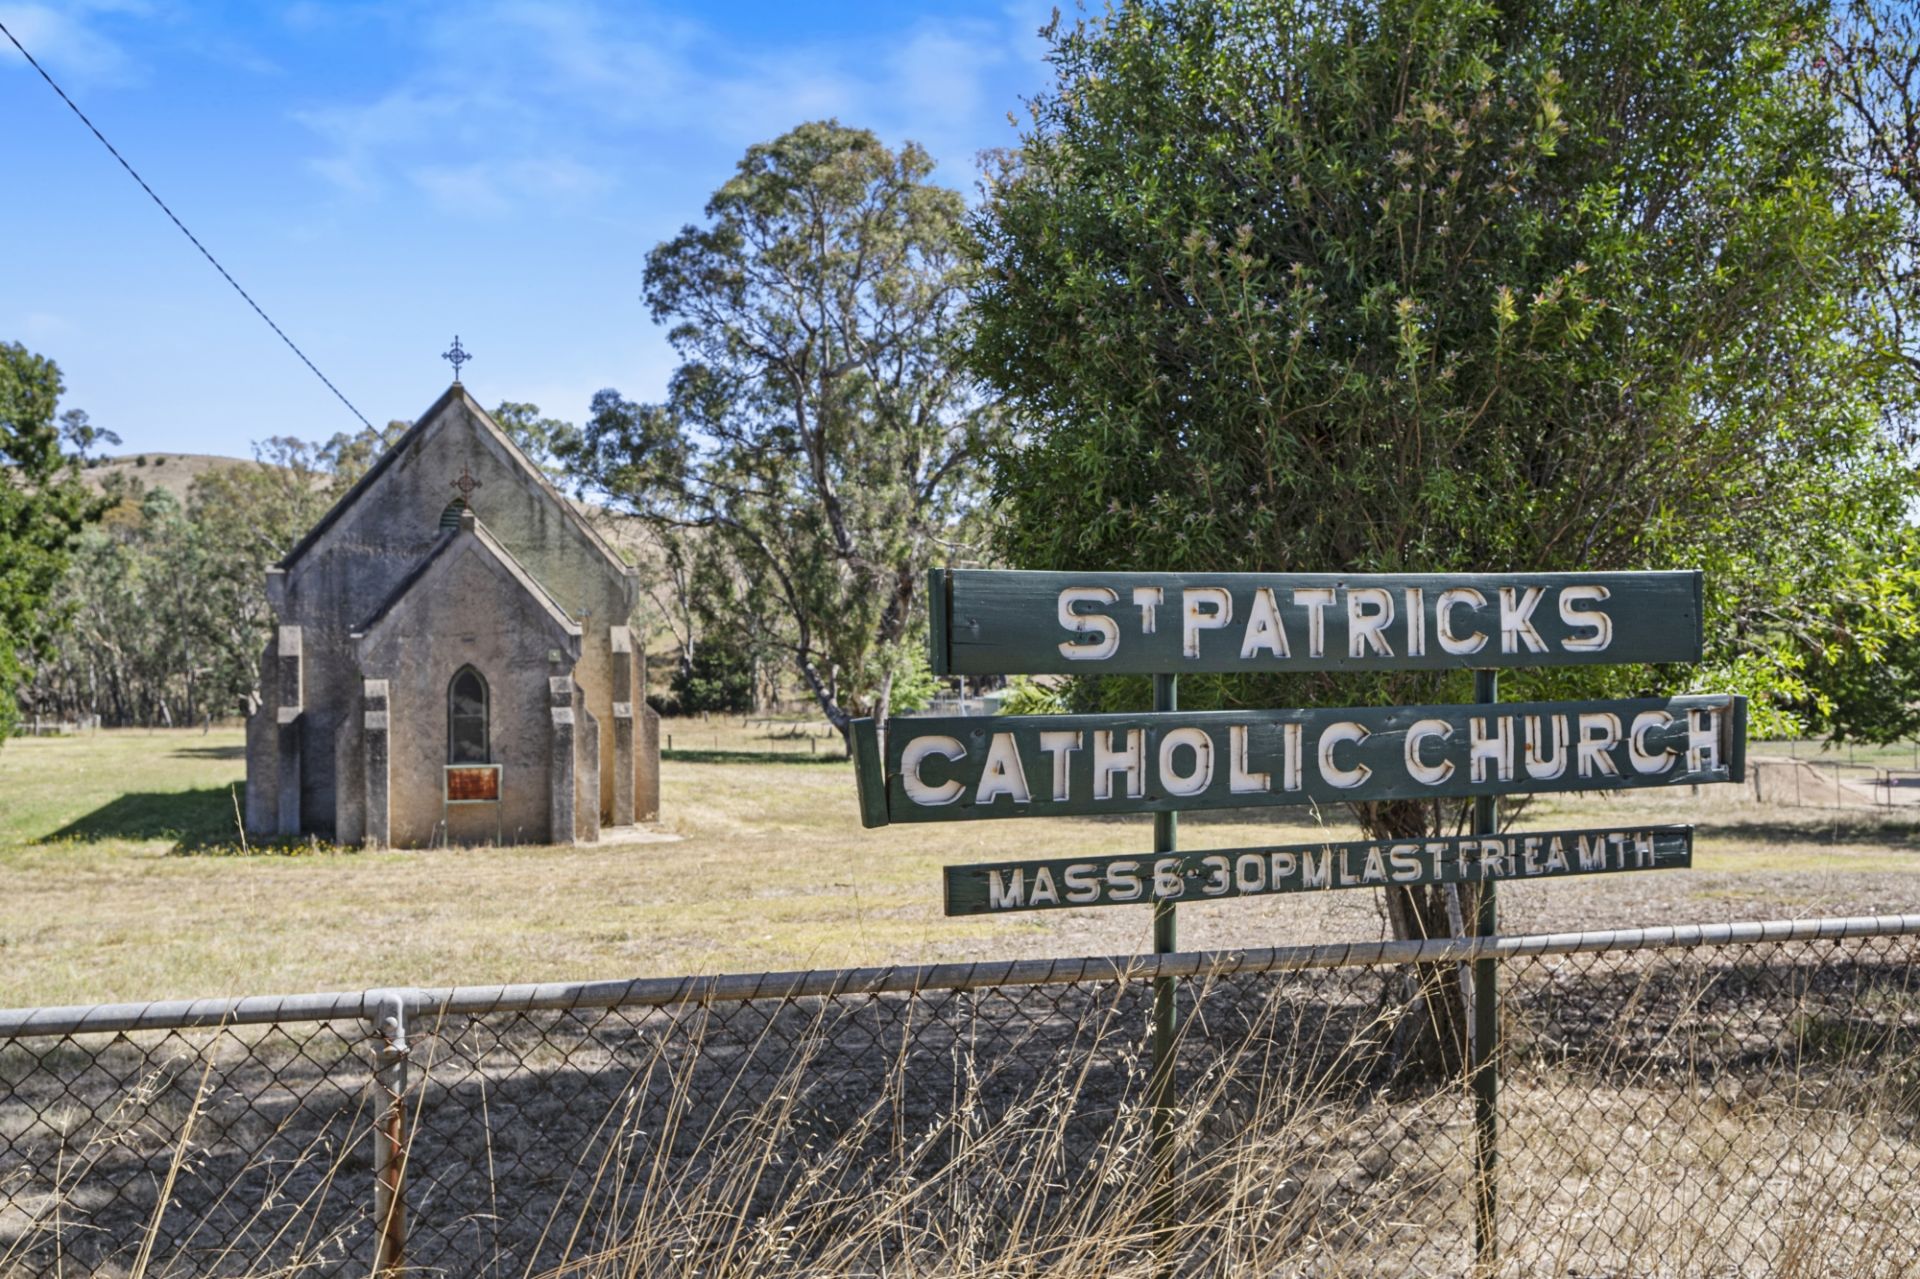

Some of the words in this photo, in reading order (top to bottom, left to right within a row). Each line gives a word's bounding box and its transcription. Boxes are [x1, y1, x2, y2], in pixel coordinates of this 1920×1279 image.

[1182, 585, 1613, 659] PATRICKS
[900, 721, 1373, 807] CATHOLIC
[1404, 708, 1726, 786] CHURCH
[988, 861, 1144, 909] MASS
[1339, 843, 1449, 885] LAST
[1458, 838, 1516, 879] FRI
[1578, 830, 1655, 871] MTH
